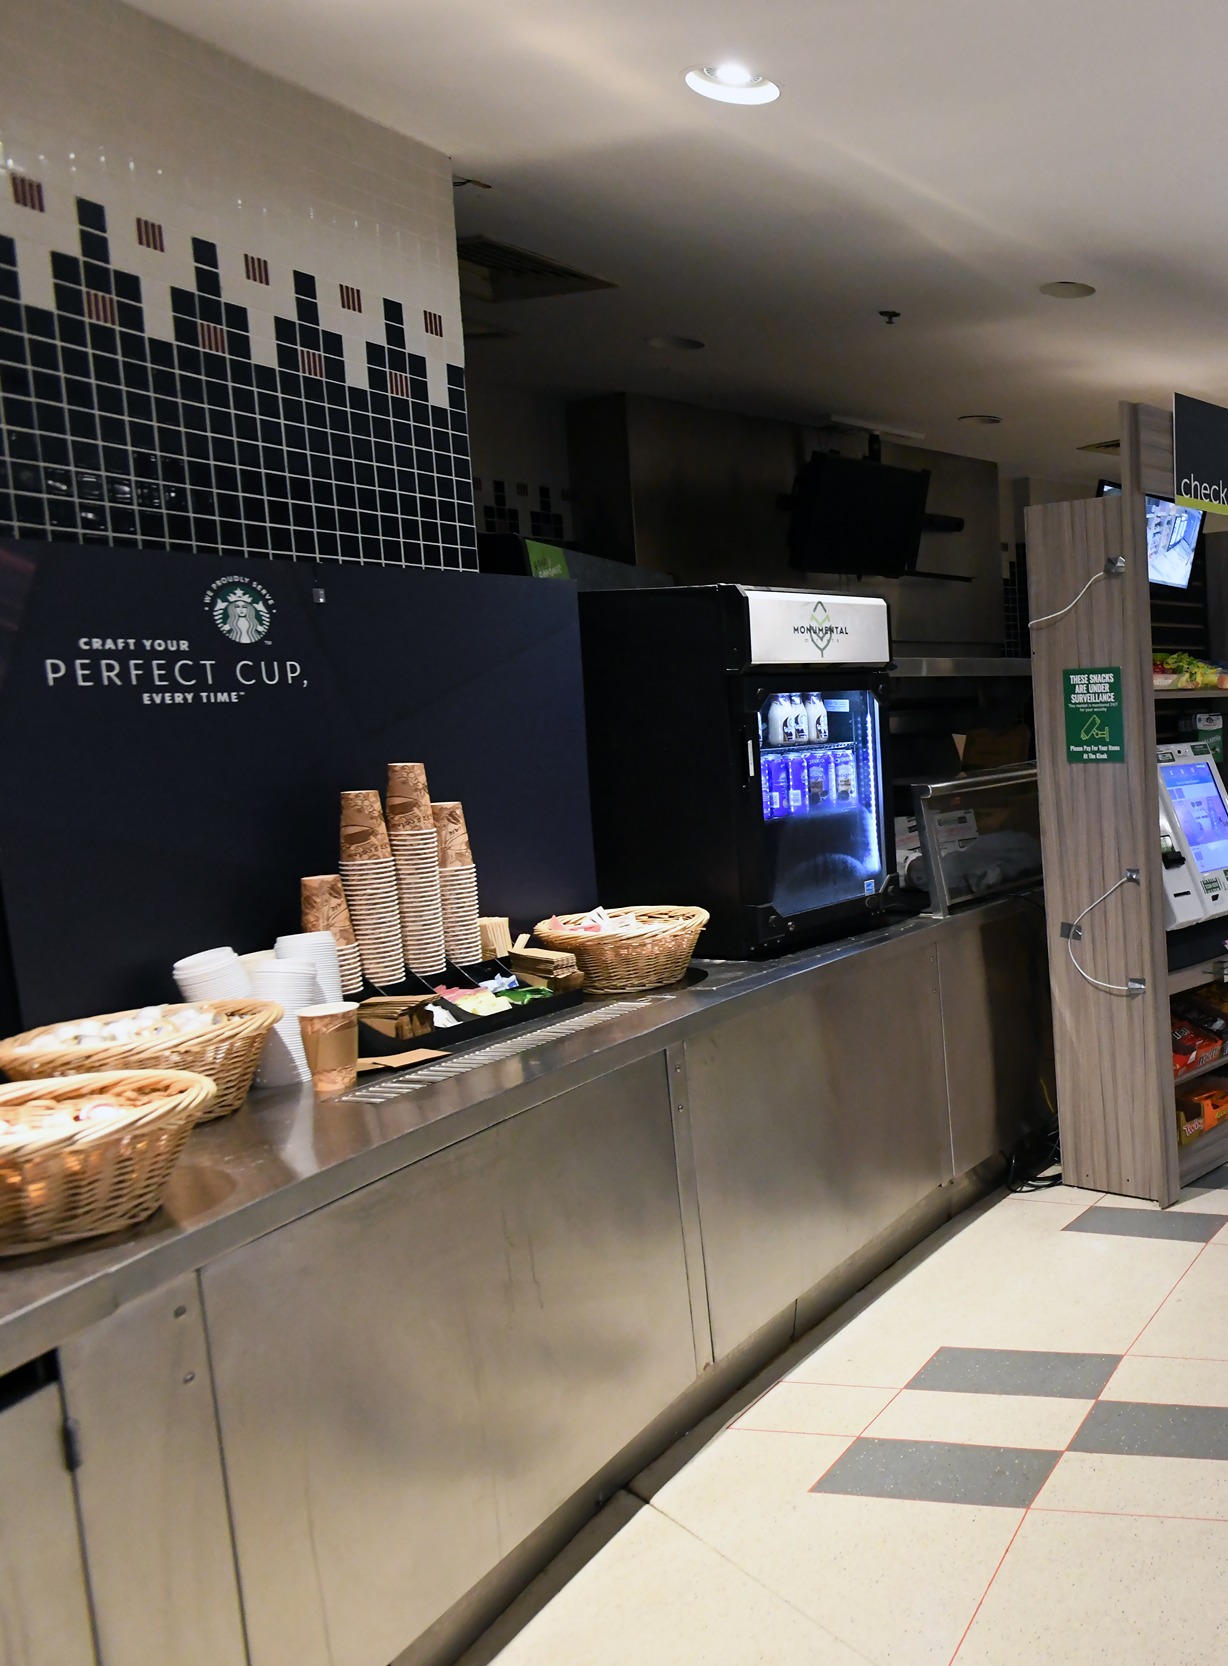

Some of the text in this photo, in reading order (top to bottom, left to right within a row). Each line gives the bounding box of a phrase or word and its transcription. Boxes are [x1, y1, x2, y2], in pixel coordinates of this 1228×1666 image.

[1181, 474, 1228, 506] check
[204, 576, 274, 604] WE PROUDLY SERVE
[793, 626, 848, 634] MONUMENTAL
[78, 638, 190, 652] CRAFT YOUR
[45, 659, 308, 688] PERFECT CUP,
[1070, 673, 1114, 684] THESE SNACKS
[1075, 683, 1110, 693] ARE UNDER
[143, 692, 194, 704] EVERY
[1071, 693, 1115, 703] SURVEILLANCE
